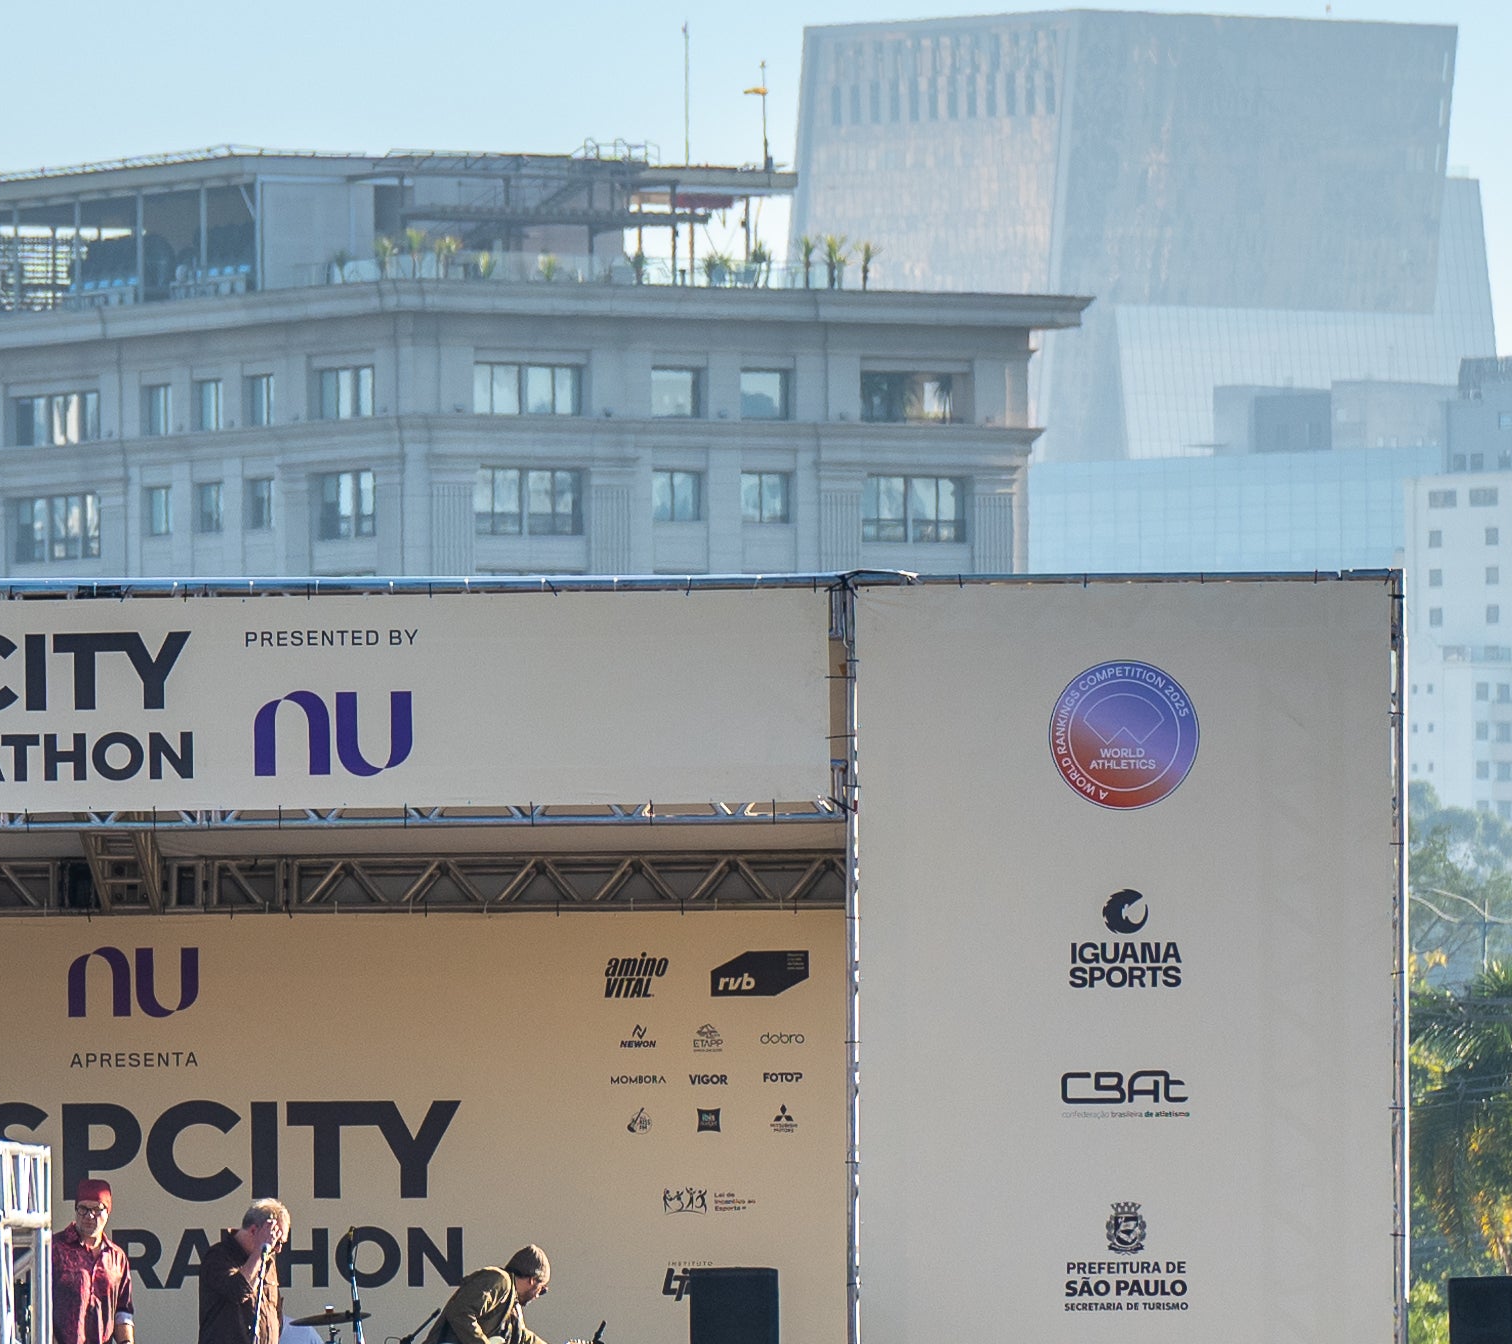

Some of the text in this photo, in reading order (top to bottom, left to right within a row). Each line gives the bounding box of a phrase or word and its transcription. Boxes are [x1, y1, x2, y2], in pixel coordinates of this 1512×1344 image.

[245, 628, 419, 648] PRESENTED BY
[1055, 665, 1190, 801] A WORLD RANKINGS COMPETITION 2025
[1099, 747, 1145, 758] WORLD
[1089, 759, 1157, 770] ATHLETICS
[1070, 941, 1182, 965] IGUANA
[604, 951, 669, 978] amino
[718, 972, 756, 991] rvb
[1069, 965, 1182, 989] SPORTS
[604, 977, 652, 999] VITAL
[619, 1039, 657, 1048] NEWON
[692, 1039, 724, 1048] ETAPP
[759, 1031, 805, 1045] dobro
[69, 1051, 198, 1069] APRESENTA
[610, 1074, 667, 1085] MOMBORA
[688, 1073, 728, 1086] VIGOR
[1066, 1260, 1187, 1275] PREFEITURA DE
[1065, 1276, 1188, 1298] SÃO PAULO
[1064, 1301, 1189, 1312] SECRETARIA DE TURISMO
